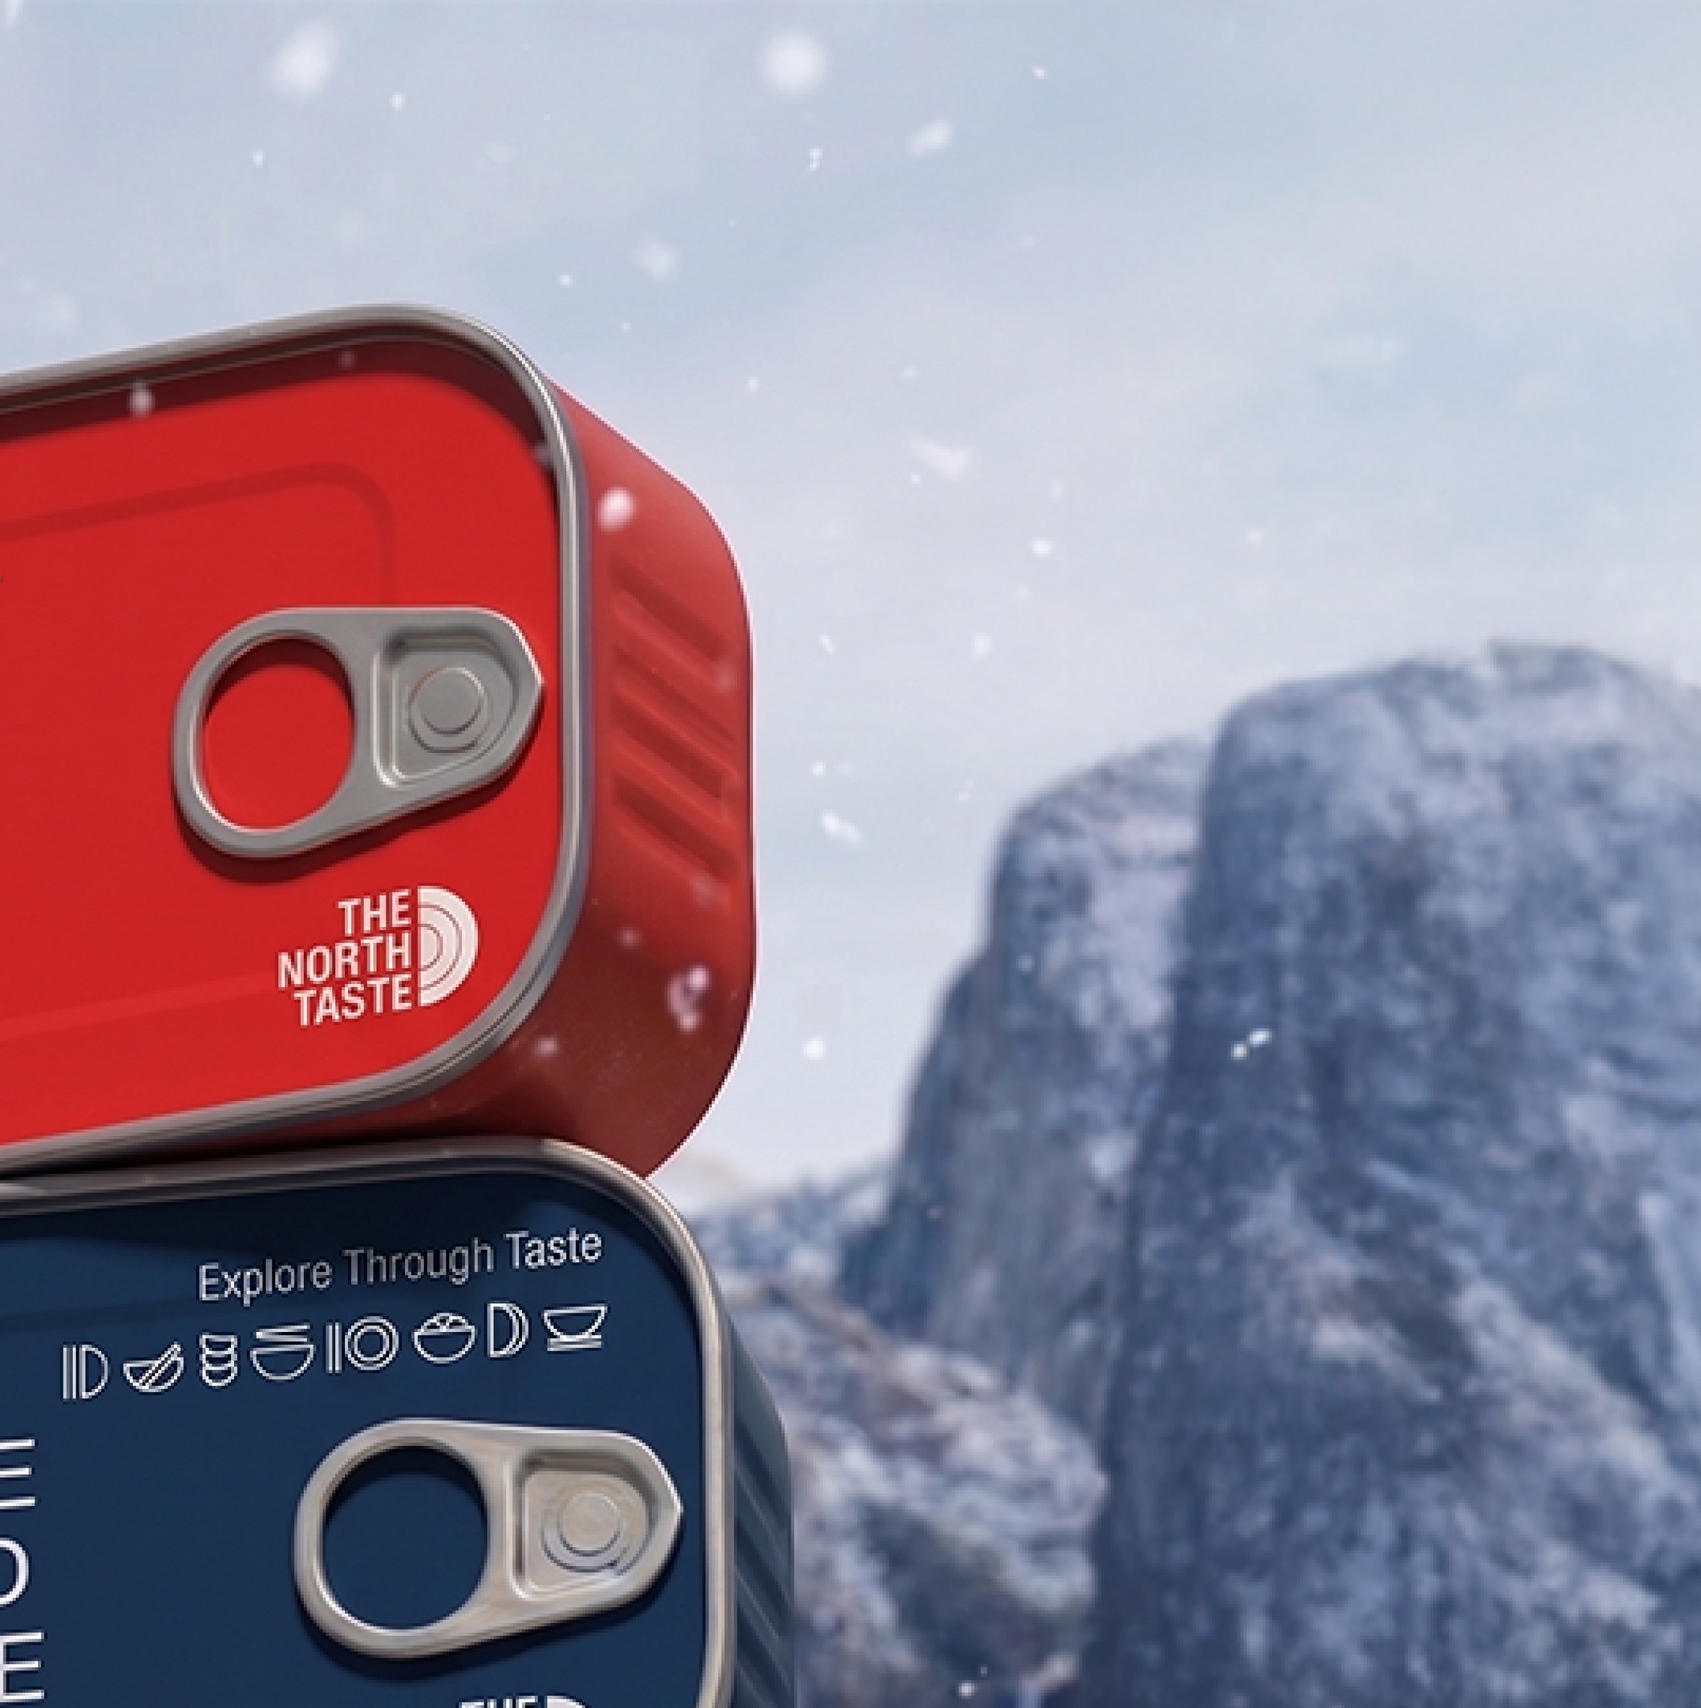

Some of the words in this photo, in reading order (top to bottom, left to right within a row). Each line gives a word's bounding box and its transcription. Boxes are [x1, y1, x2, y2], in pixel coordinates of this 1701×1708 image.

[339, 889, 411, 936] THE
[279, 933, 411, 987] NORTH
[294, 974, 411, 1025] TASTE
[200, 1262, 329, 1306] Explore
[343, 1240, 493, 1284] Through
[506, 1228, 601, 1269] Taste
